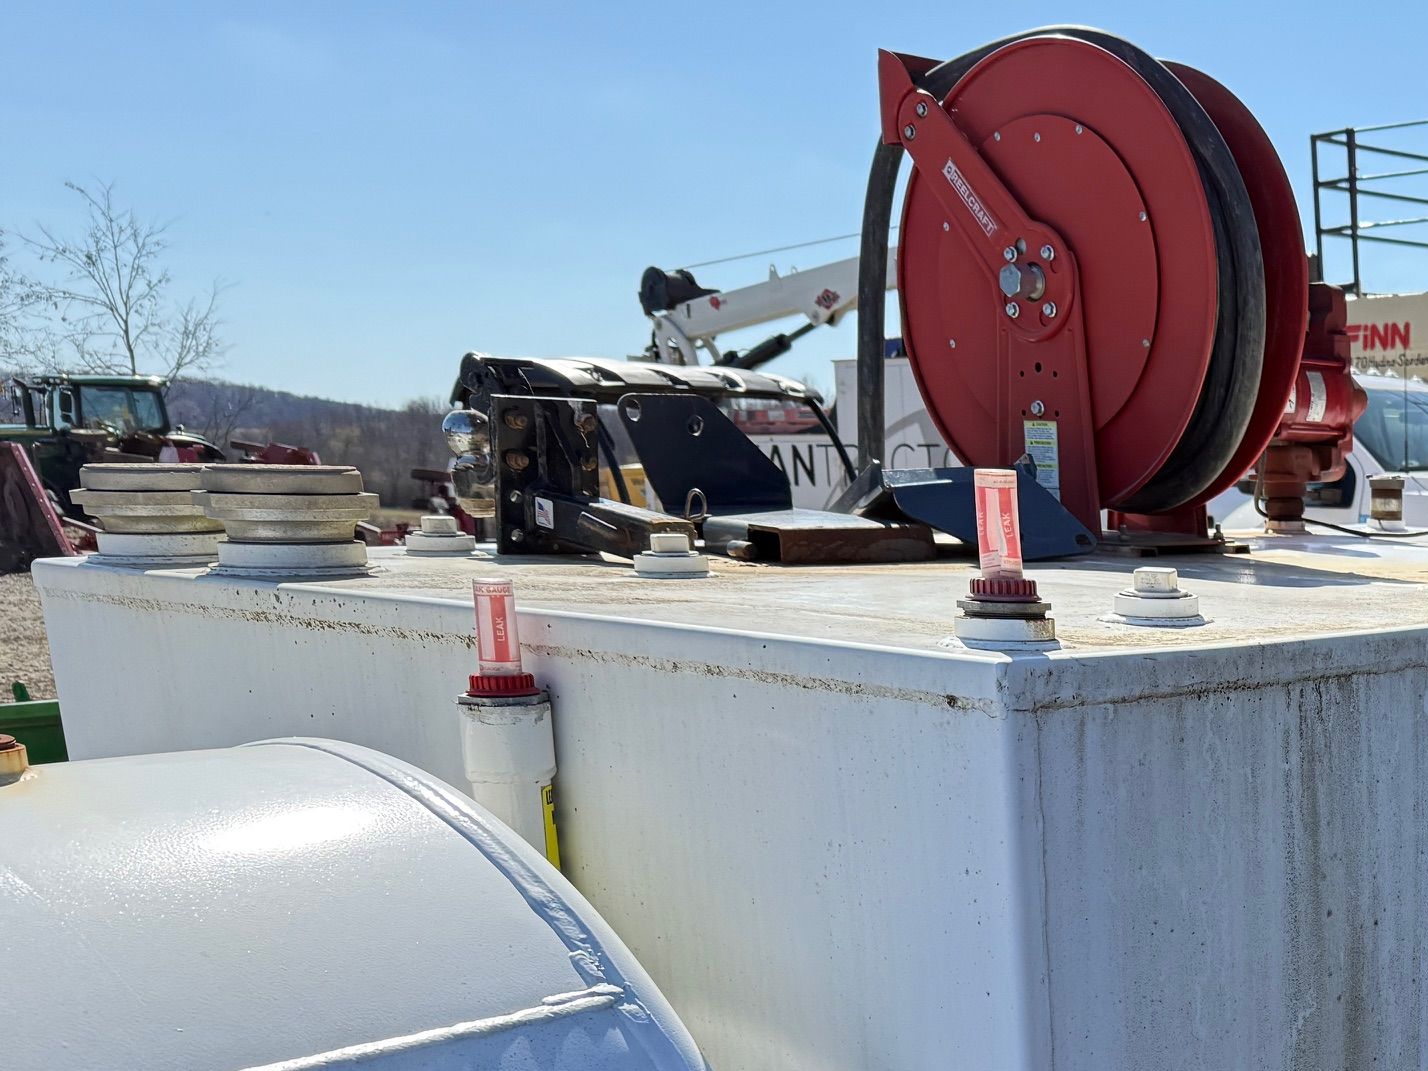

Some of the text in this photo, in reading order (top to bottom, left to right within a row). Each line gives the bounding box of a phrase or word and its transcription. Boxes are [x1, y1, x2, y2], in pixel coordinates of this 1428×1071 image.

[950, 171, 994, 232] REELCRAFT
[1001, 512, 1014, 538] LEAK
[495, 617, 506, 642] LEAK
